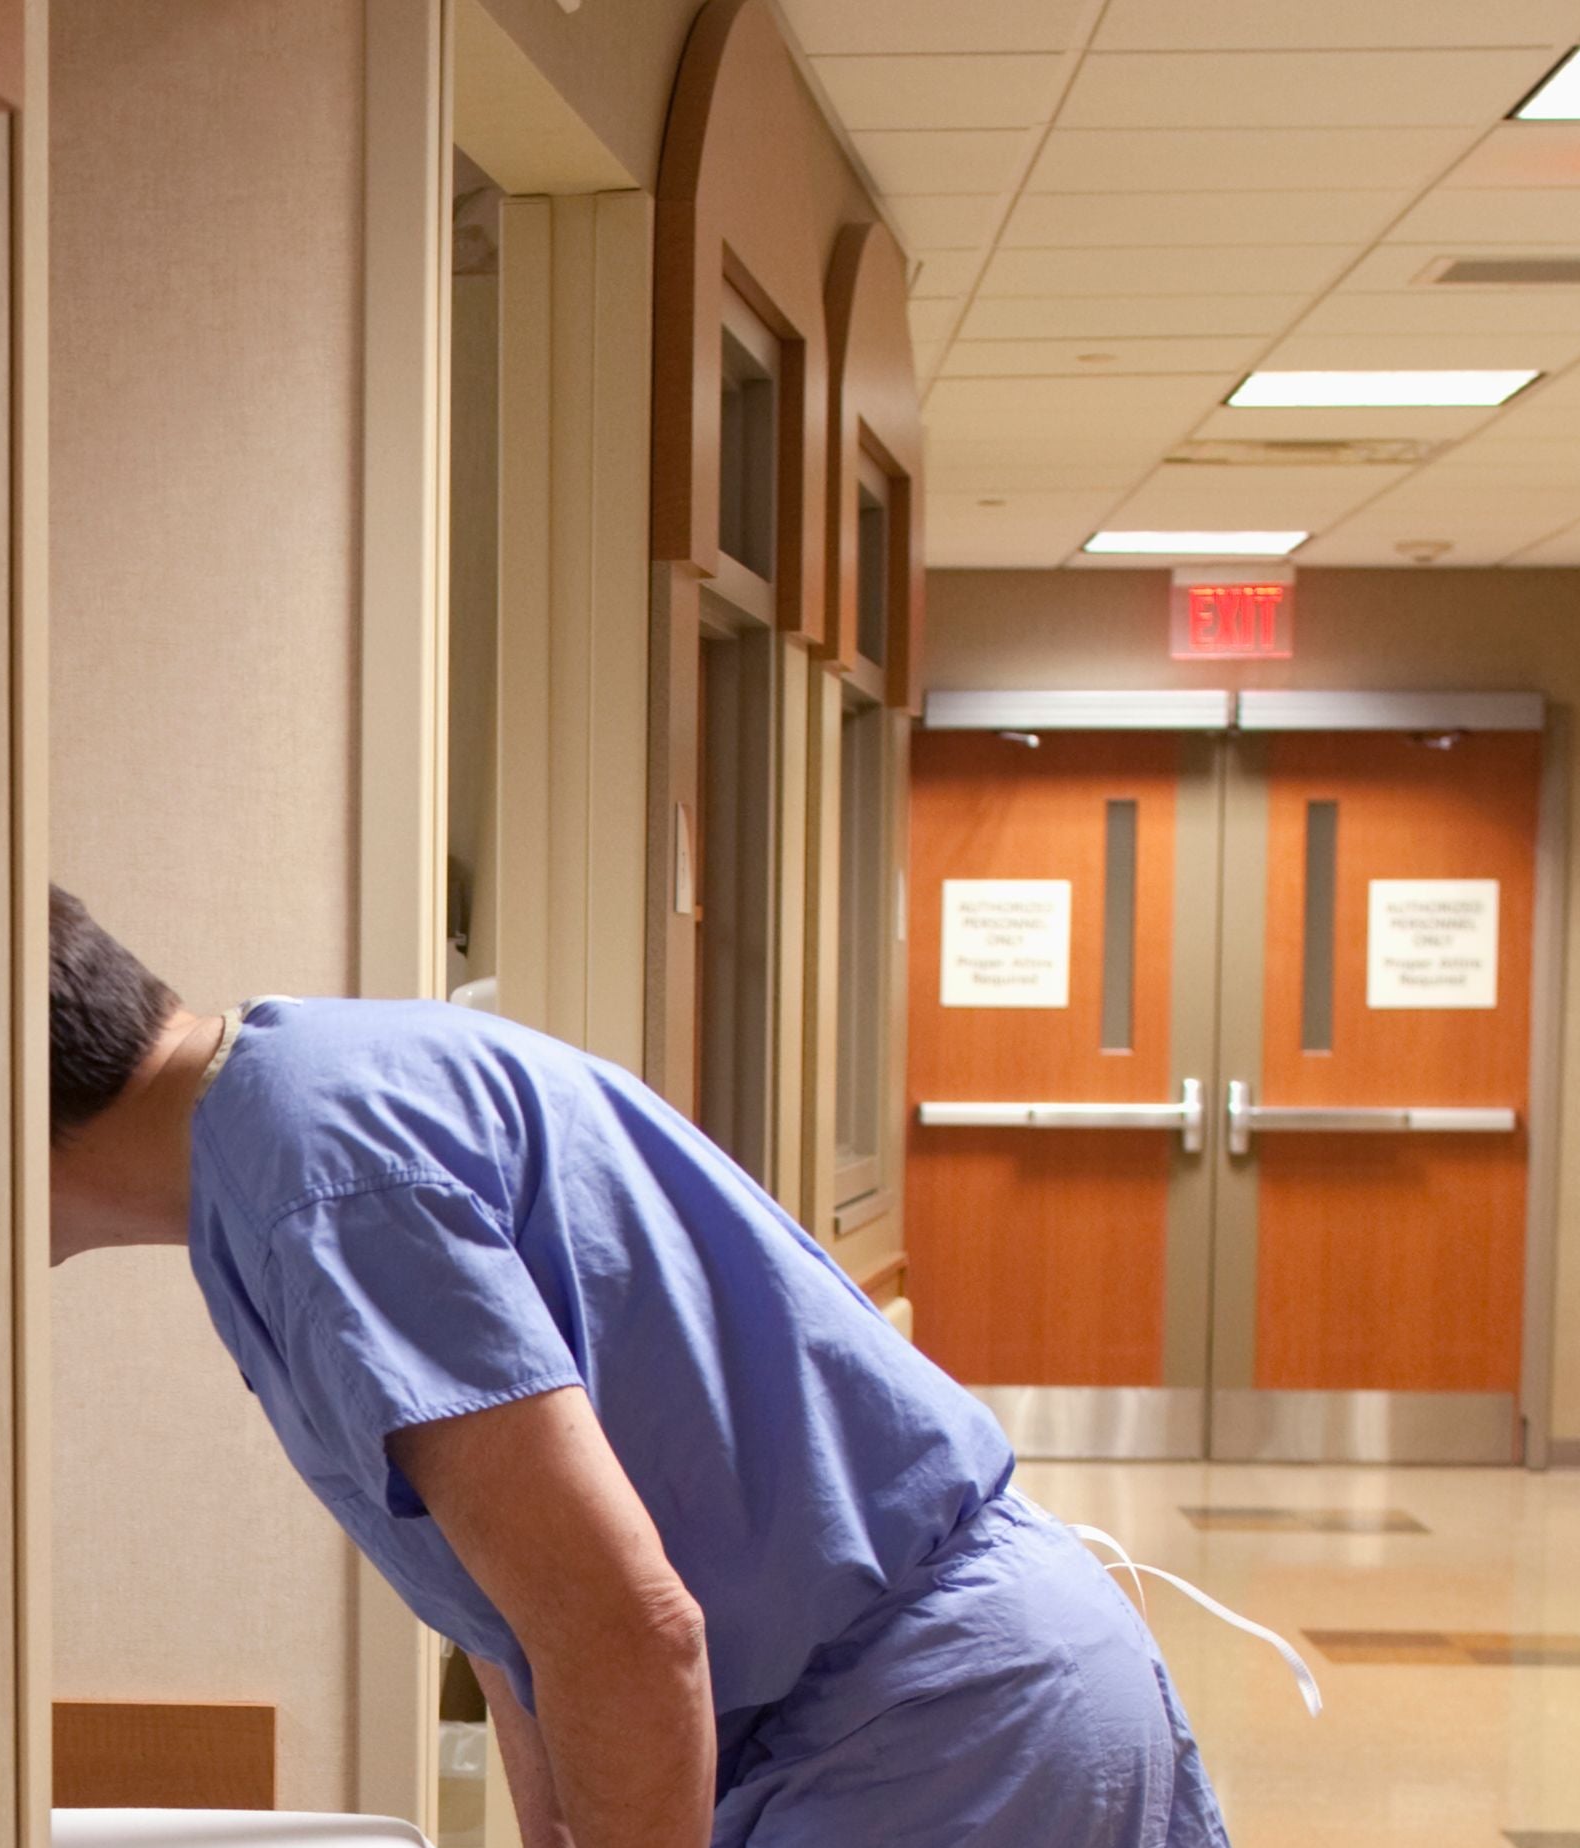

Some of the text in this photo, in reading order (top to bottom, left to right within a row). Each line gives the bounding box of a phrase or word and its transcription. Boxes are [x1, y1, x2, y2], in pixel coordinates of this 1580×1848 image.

[1188, 586, 1283, 652] EXIT
[964, 917, 1046, 929] PERSONNEL
[1391, 918, 1476, 929] PERSONNEL
[987, 934, 1023, 945] ONLY
[1414, 935, 1452, 946] ONLY
